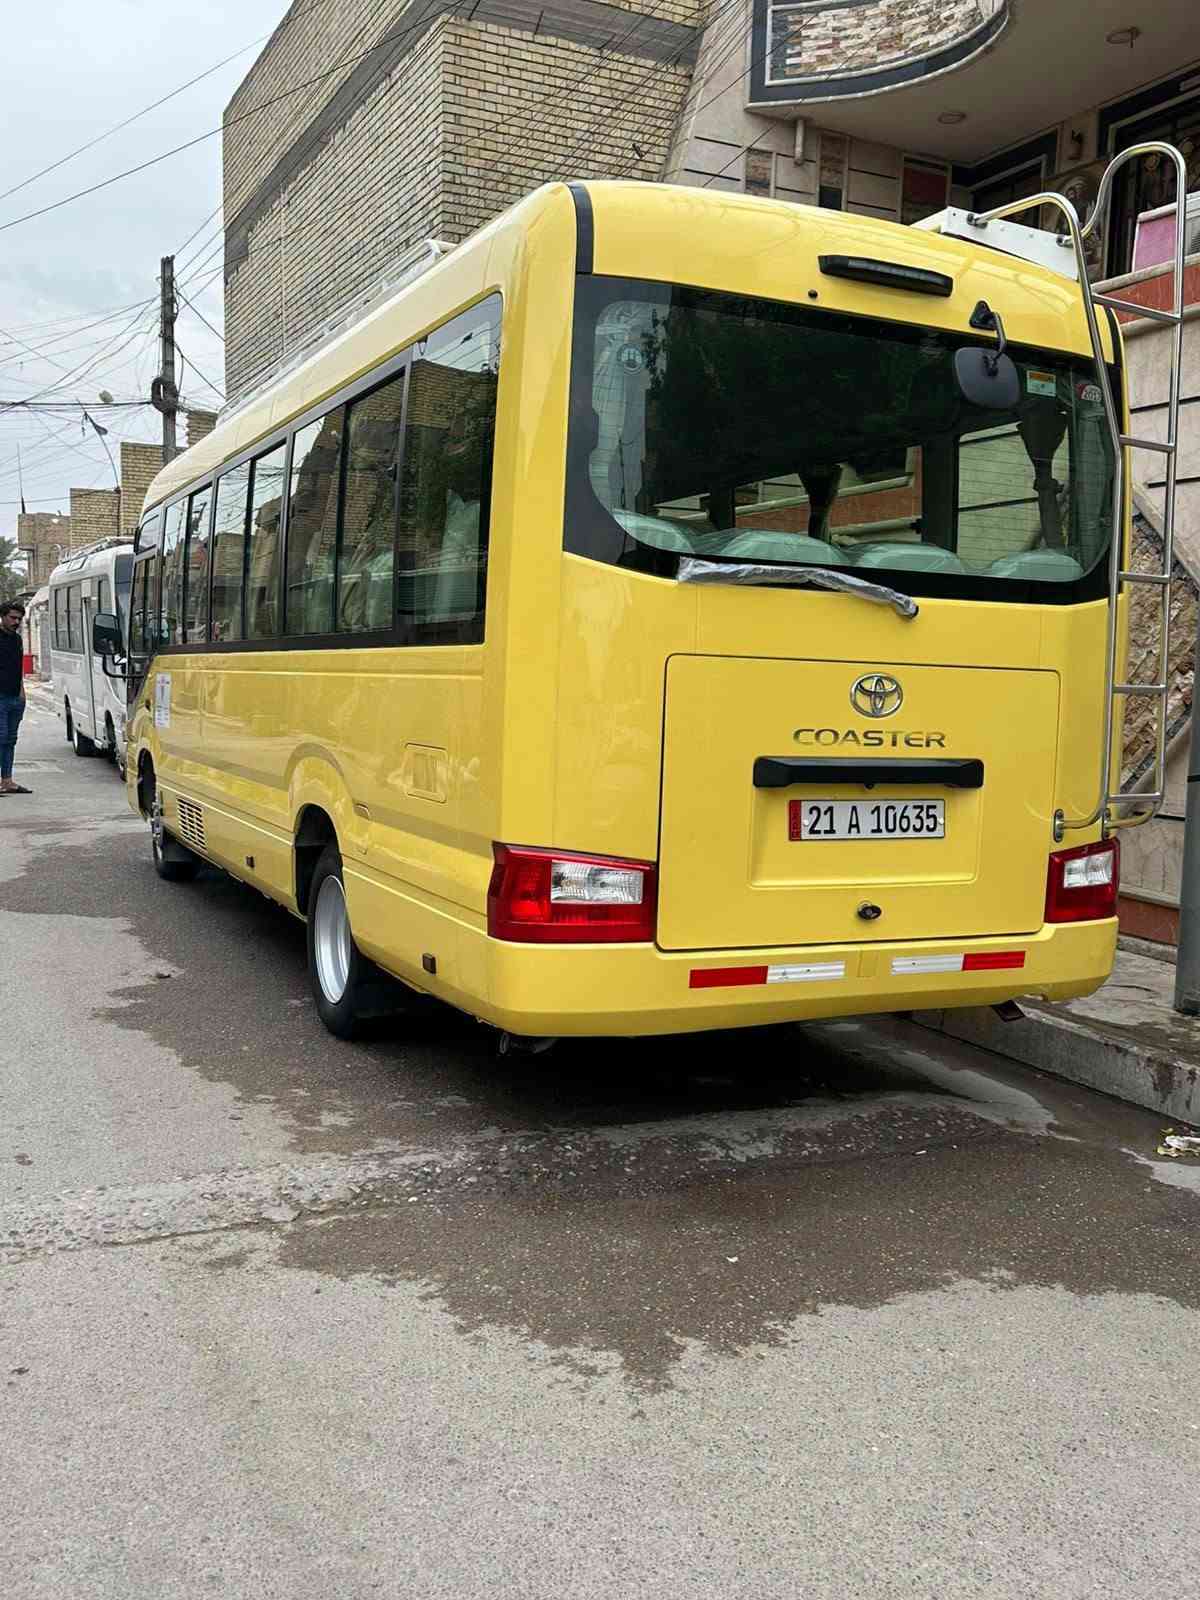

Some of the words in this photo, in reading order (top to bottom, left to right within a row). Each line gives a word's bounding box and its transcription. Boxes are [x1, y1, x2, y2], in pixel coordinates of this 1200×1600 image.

[793, 728, 946, 748] COASTER
[808, 805, 836, 835] 21
[847, 805, 861, 834] A
[870, 804, 938, 833] 10635
